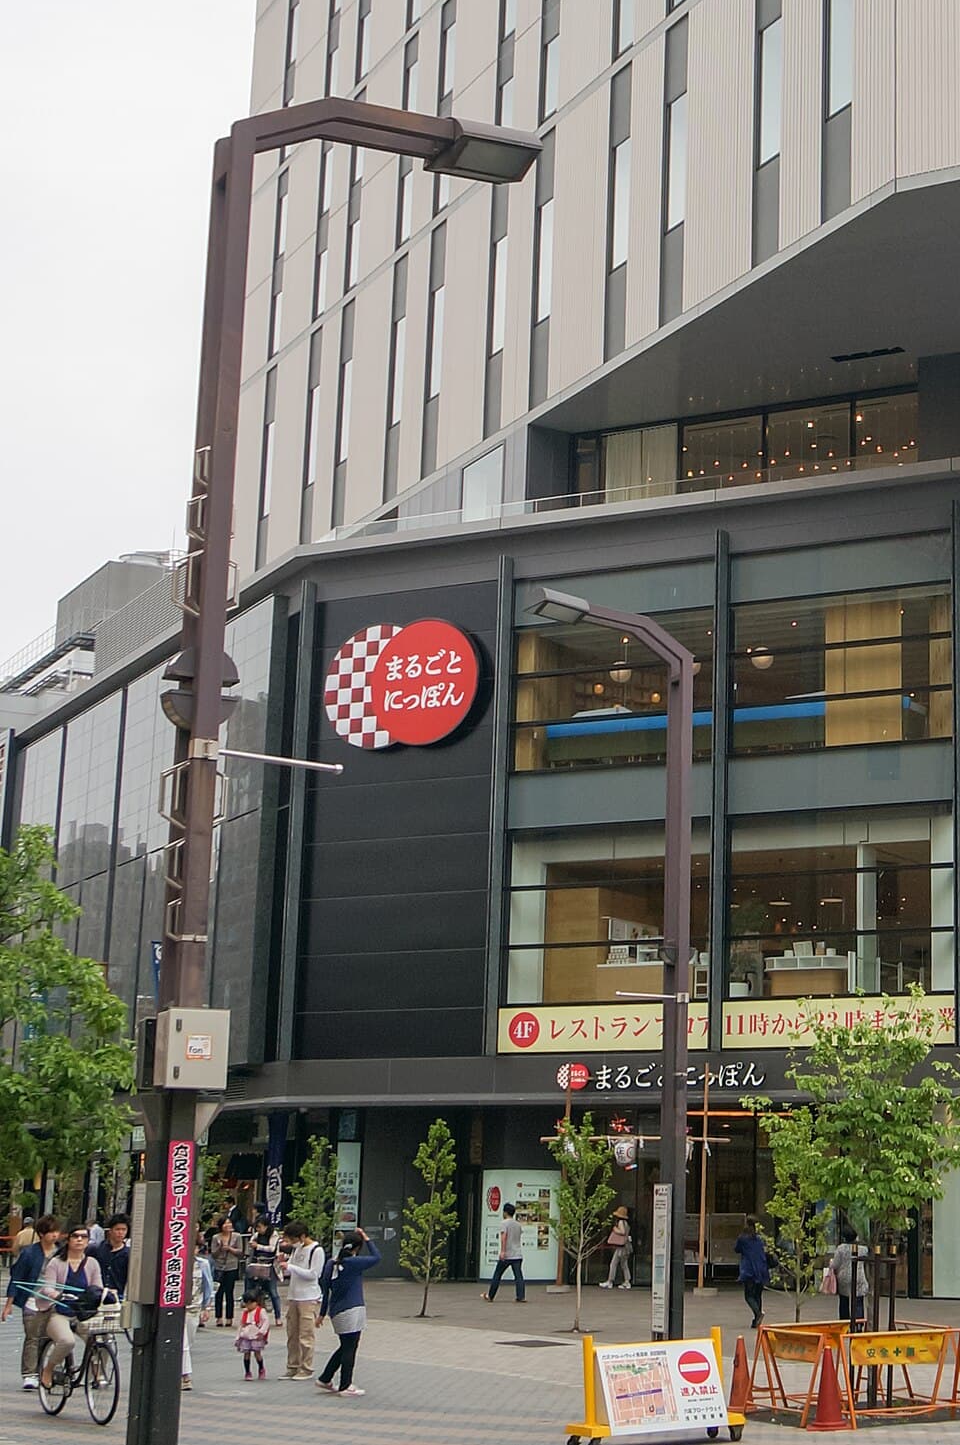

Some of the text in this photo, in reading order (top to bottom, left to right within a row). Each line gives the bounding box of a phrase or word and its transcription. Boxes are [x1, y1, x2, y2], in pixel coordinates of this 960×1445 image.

[385, 648, 462, 681] まるごと
[384, 682, 465, 712] にっぽん
[512, 1020, 536, 1039] 4F
[680, 1385, 718, 1397] 進入禁止
